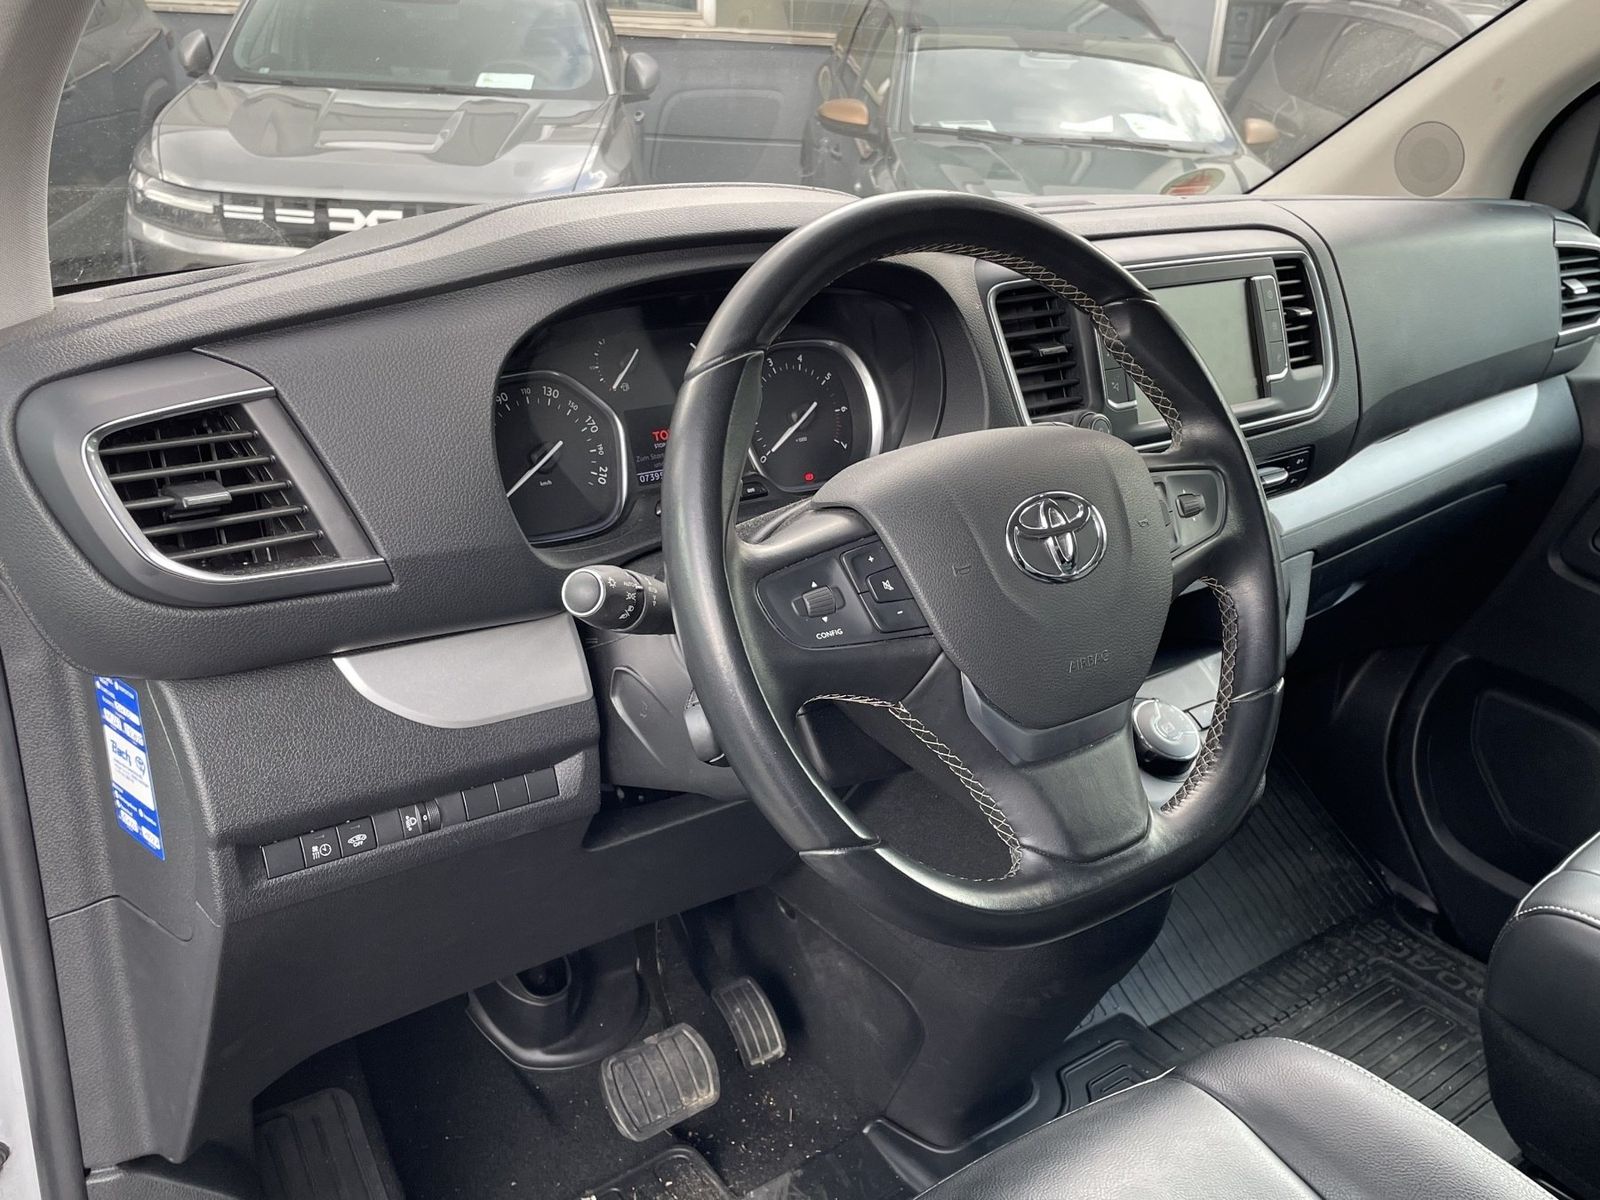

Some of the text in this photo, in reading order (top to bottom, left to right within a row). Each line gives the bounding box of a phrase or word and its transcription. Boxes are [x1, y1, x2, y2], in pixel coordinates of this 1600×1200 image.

[767, 358, 774, 367] 3
[825, 372, 832, 381] 5
[521, 388, 531, 396] 110
[543, 386, 559, 399] 130
[496, 392, 509, 405] 90
[568, 400, 578, 411] 150
[585, 415, 599, 433] 170
[652, 429, 670, 441] TO
[841, 441, 848, 449] 7
[760, 455, 767, 463] 0
[598, 466, 608, 485] 210
[815, 628, 844, 640] CONFIG
